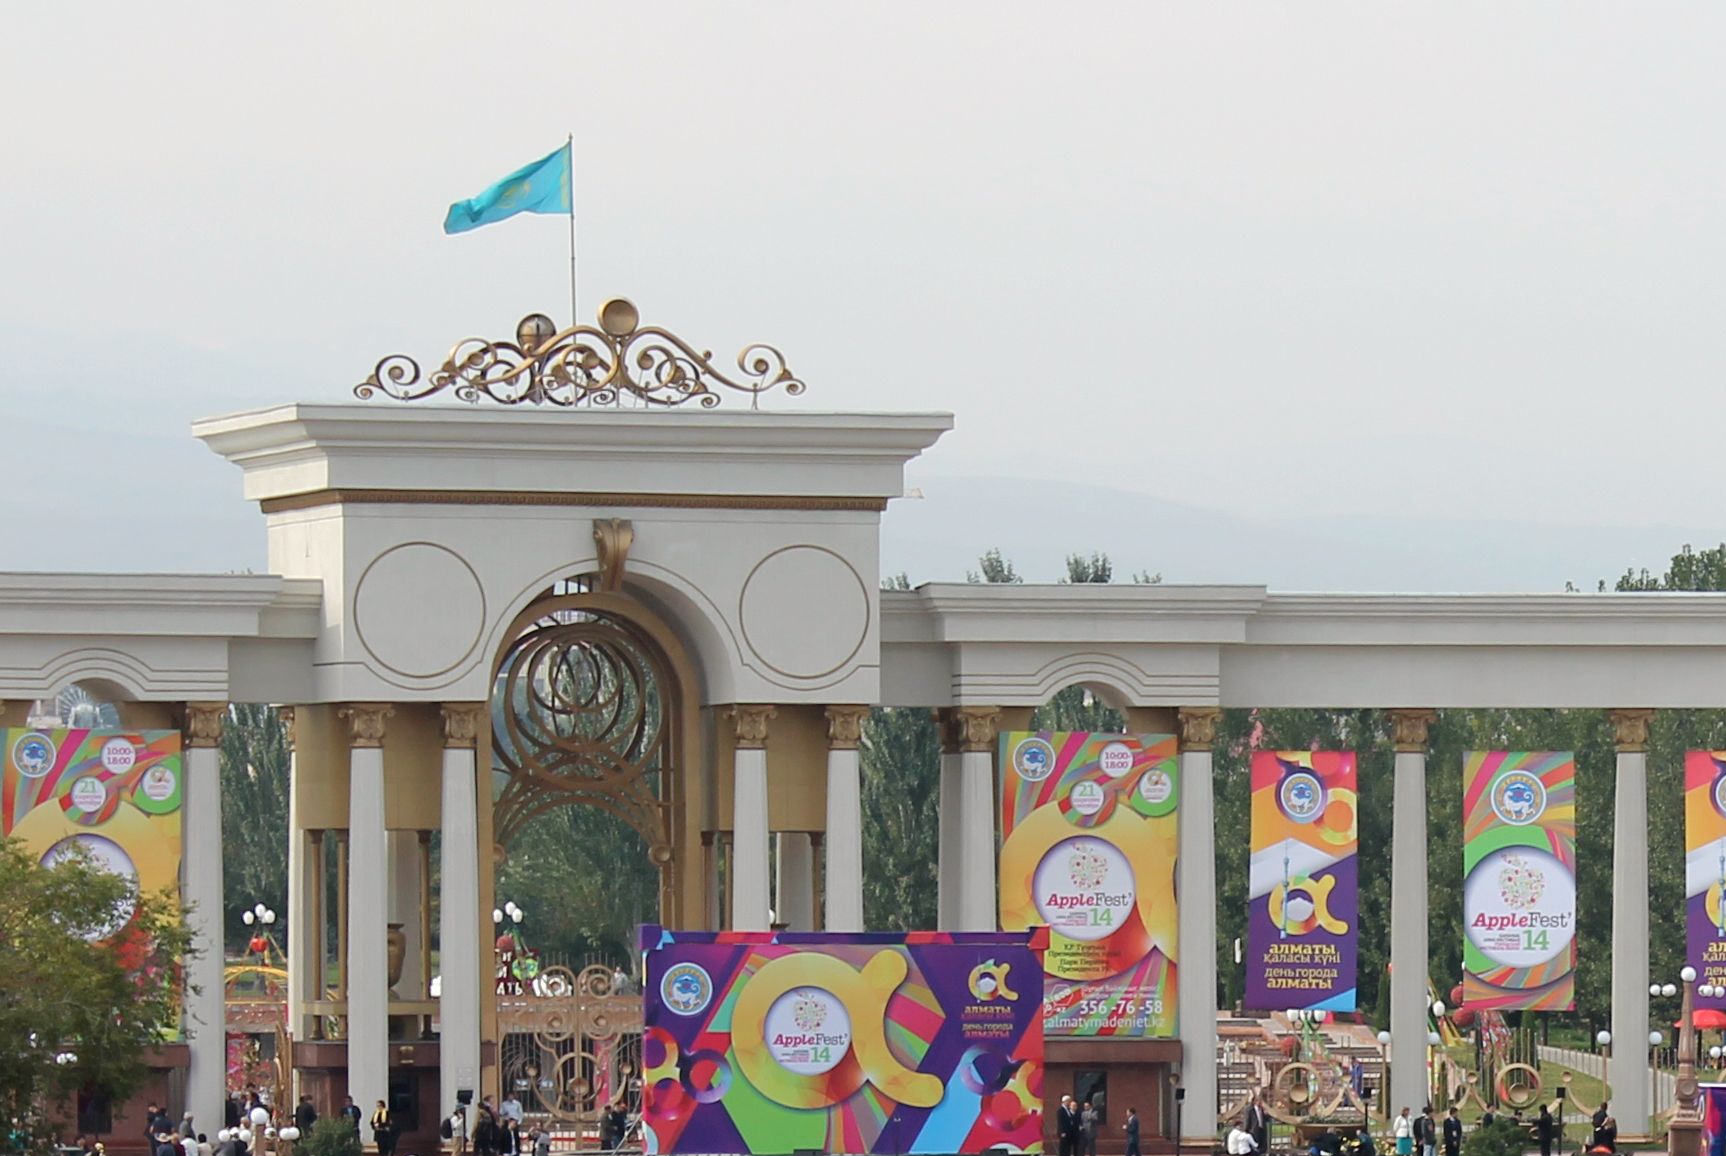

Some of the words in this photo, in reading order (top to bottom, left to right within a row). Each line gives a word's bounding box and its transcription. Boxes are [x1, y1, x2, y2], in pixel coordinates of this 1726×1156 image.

[106, 747, 133, 756] 10:00-
[1104, 752, 1130, 760] 10:00-
[106, 757, 131, 765] 18:00
[80, 780, 96, 793] 21
[1079, 784, 1094, 797] 21
[1090, 908, 1113, 926] 14
[1522, 929, 1550, 950] 14
[1269, 943, 1335, 954] алматы
[1264, 968, 1294, 978] день
[1296, 968, 1338, 980] города
[1267, 978, 1332, 989] алматы
[1080, 1001, 1107, 1014] 356
[1043, 1016, 1165, 1030] .almatymadeniet.kz
[811, 1047, 831, 1063] 14
